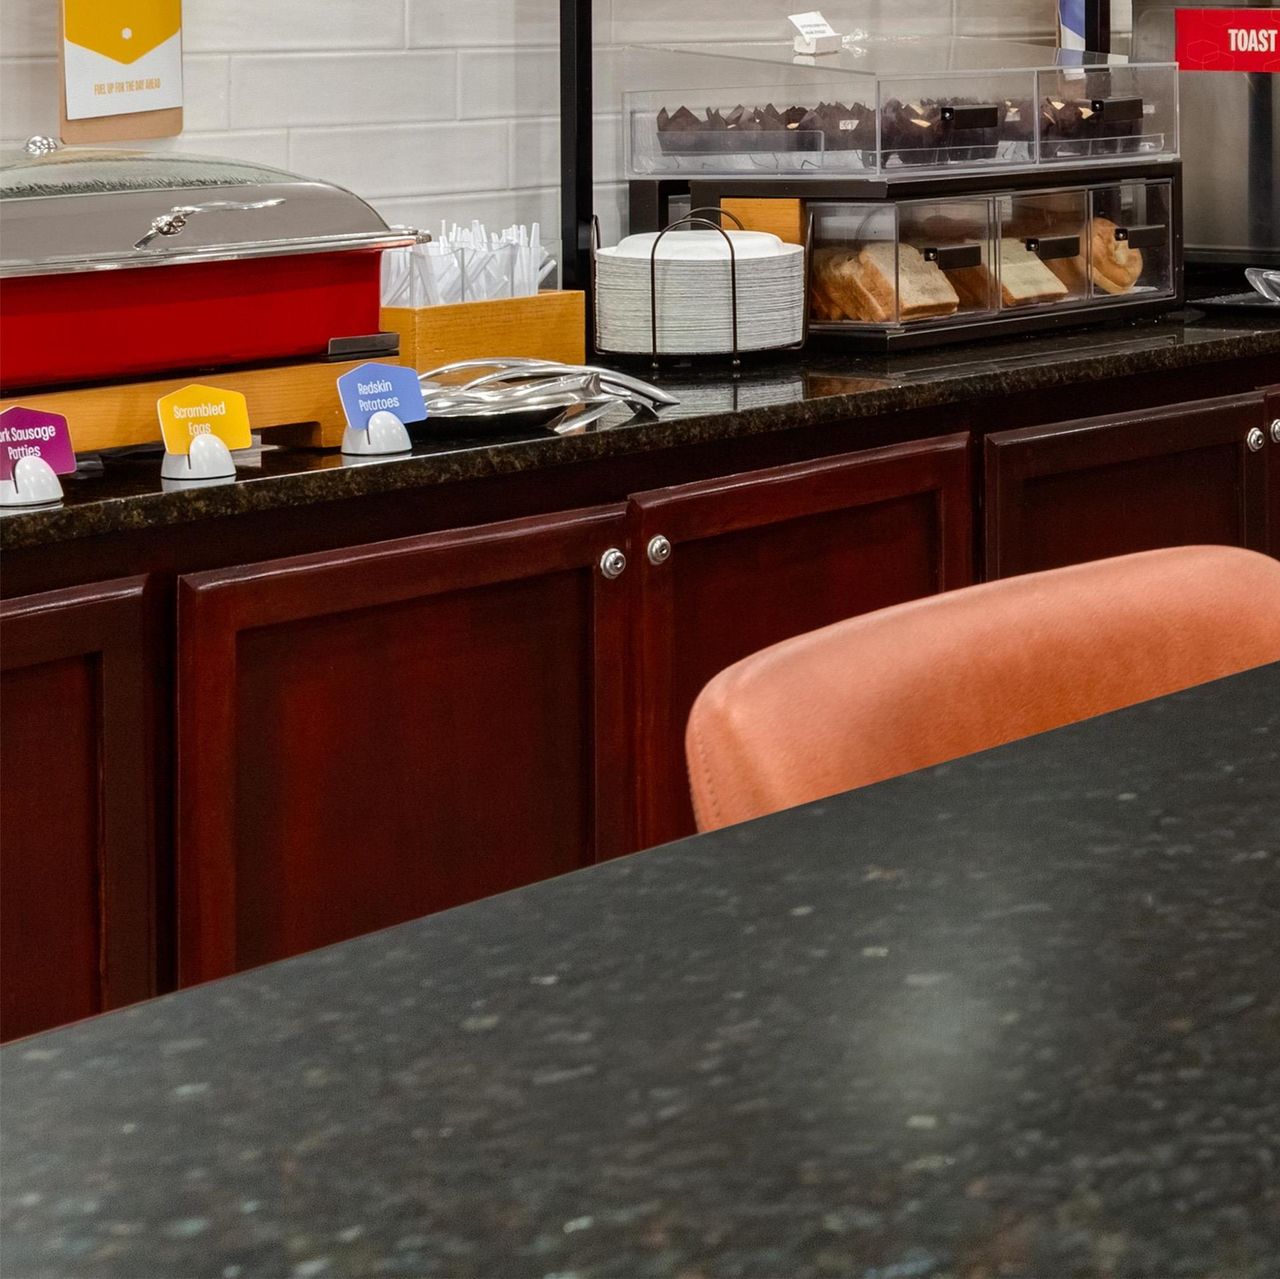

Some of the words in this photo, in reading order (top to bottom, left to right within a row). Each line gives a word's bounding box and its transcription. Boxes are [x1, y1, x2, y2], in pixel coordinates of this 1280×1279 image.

[1228, 28, 1278, 52] TOAST
[357, 380, 393, 396] Redskin
[173, 401, 226, 419] Scrambled
[358, 396, 400, 412] Potatoes
[11, 425, 56, 441] Sausage
[7, 445, 42, 460] Patties
